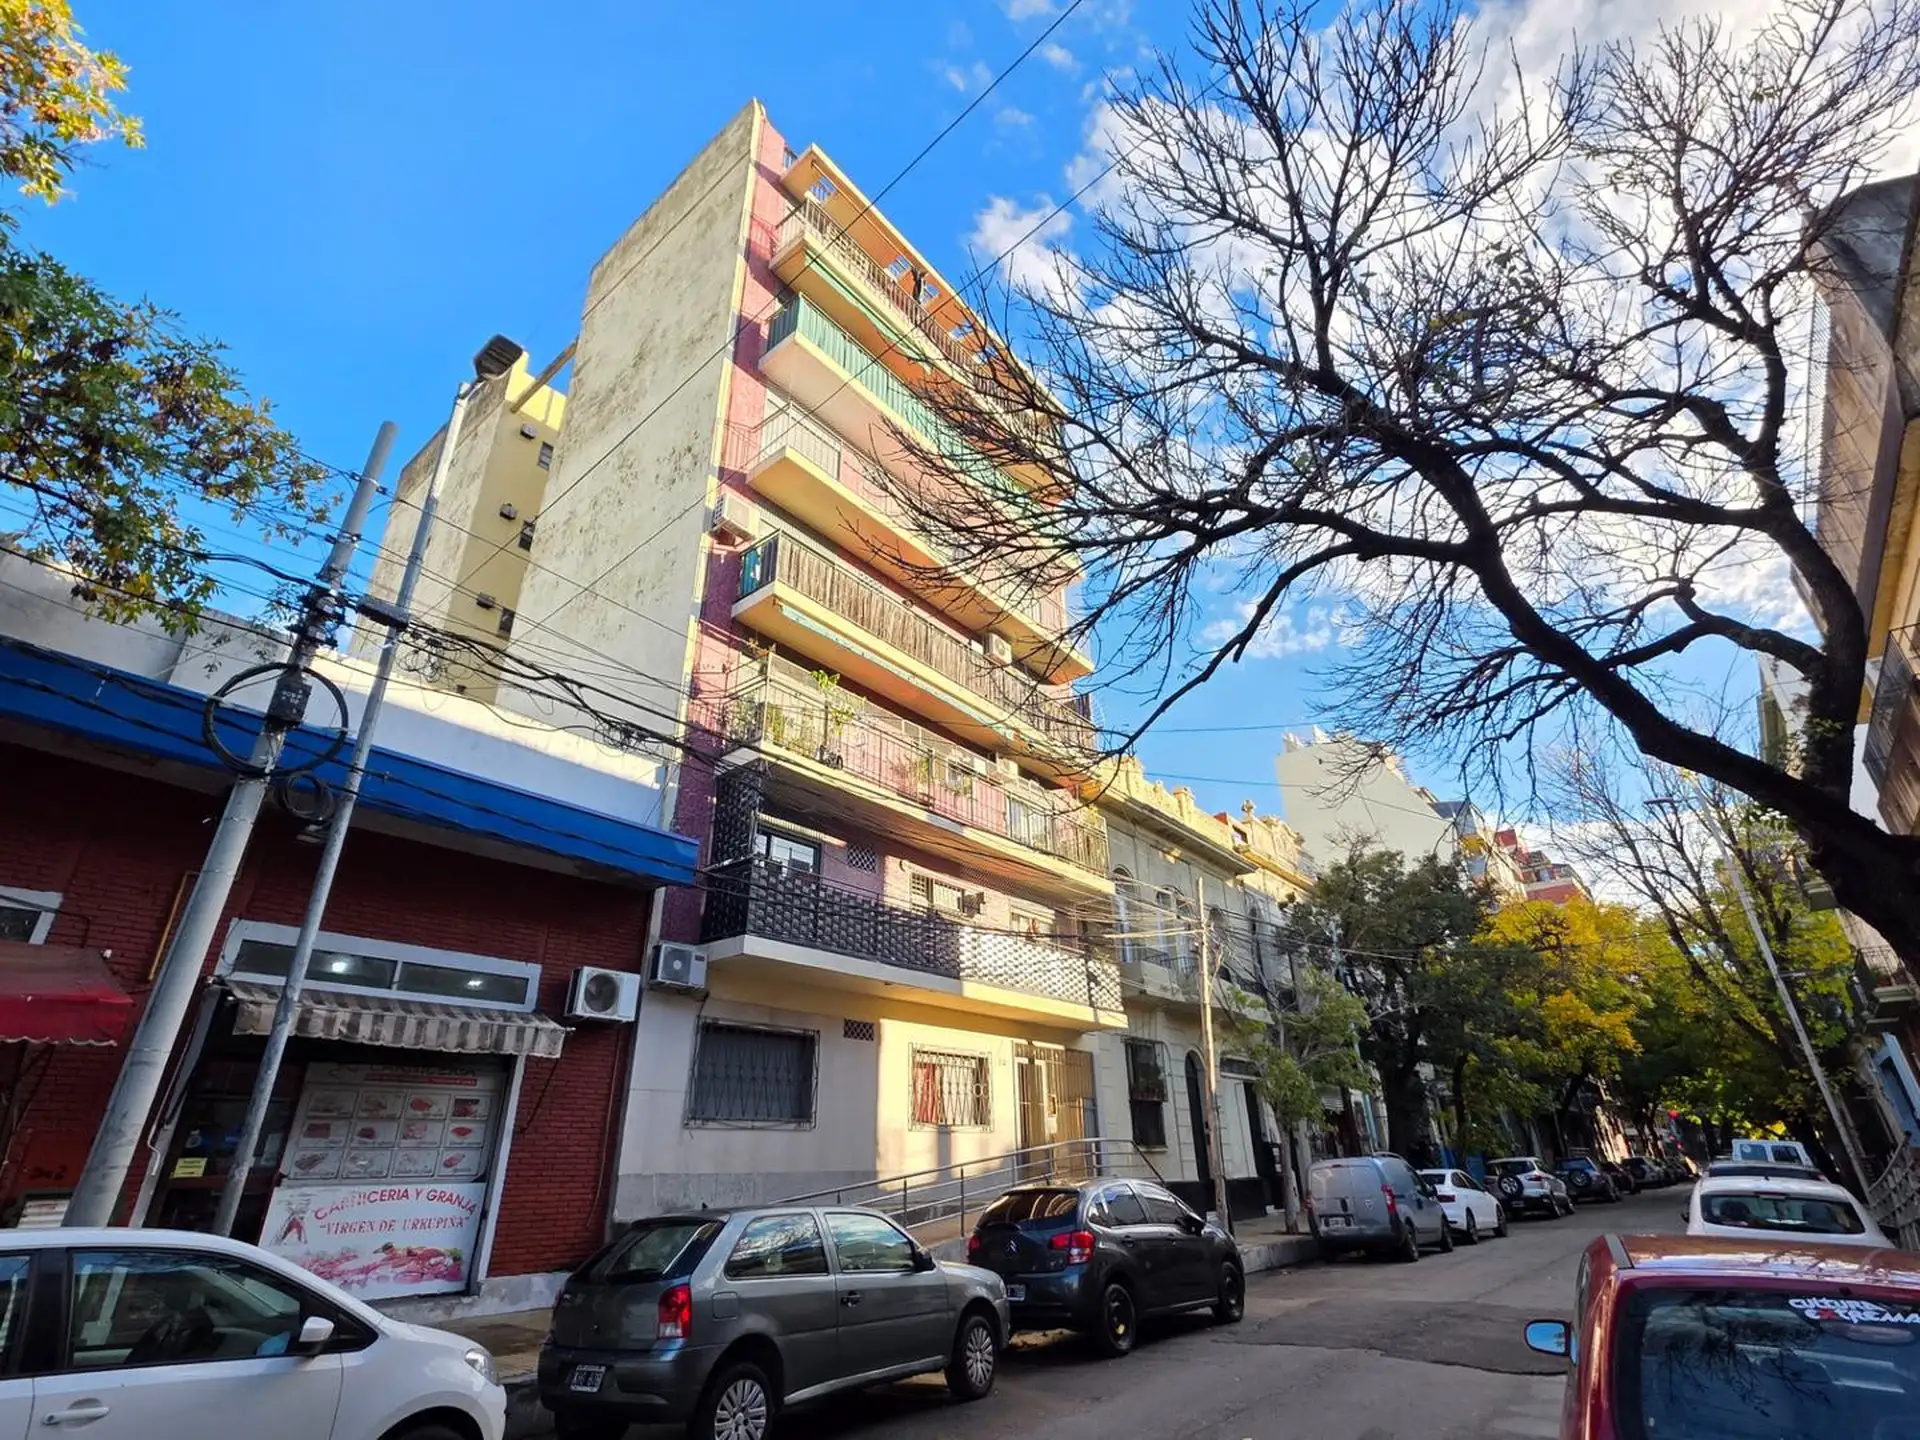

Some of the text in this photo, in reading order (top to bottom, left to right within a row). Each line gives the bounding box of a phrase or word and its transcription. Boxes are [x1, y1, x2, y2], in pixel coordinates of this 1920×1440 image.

[415, 1188, 423, 1200] Y
[426, 1188, 476, 1215] GRANJA
[378, 1219, 396, 1232] DE
